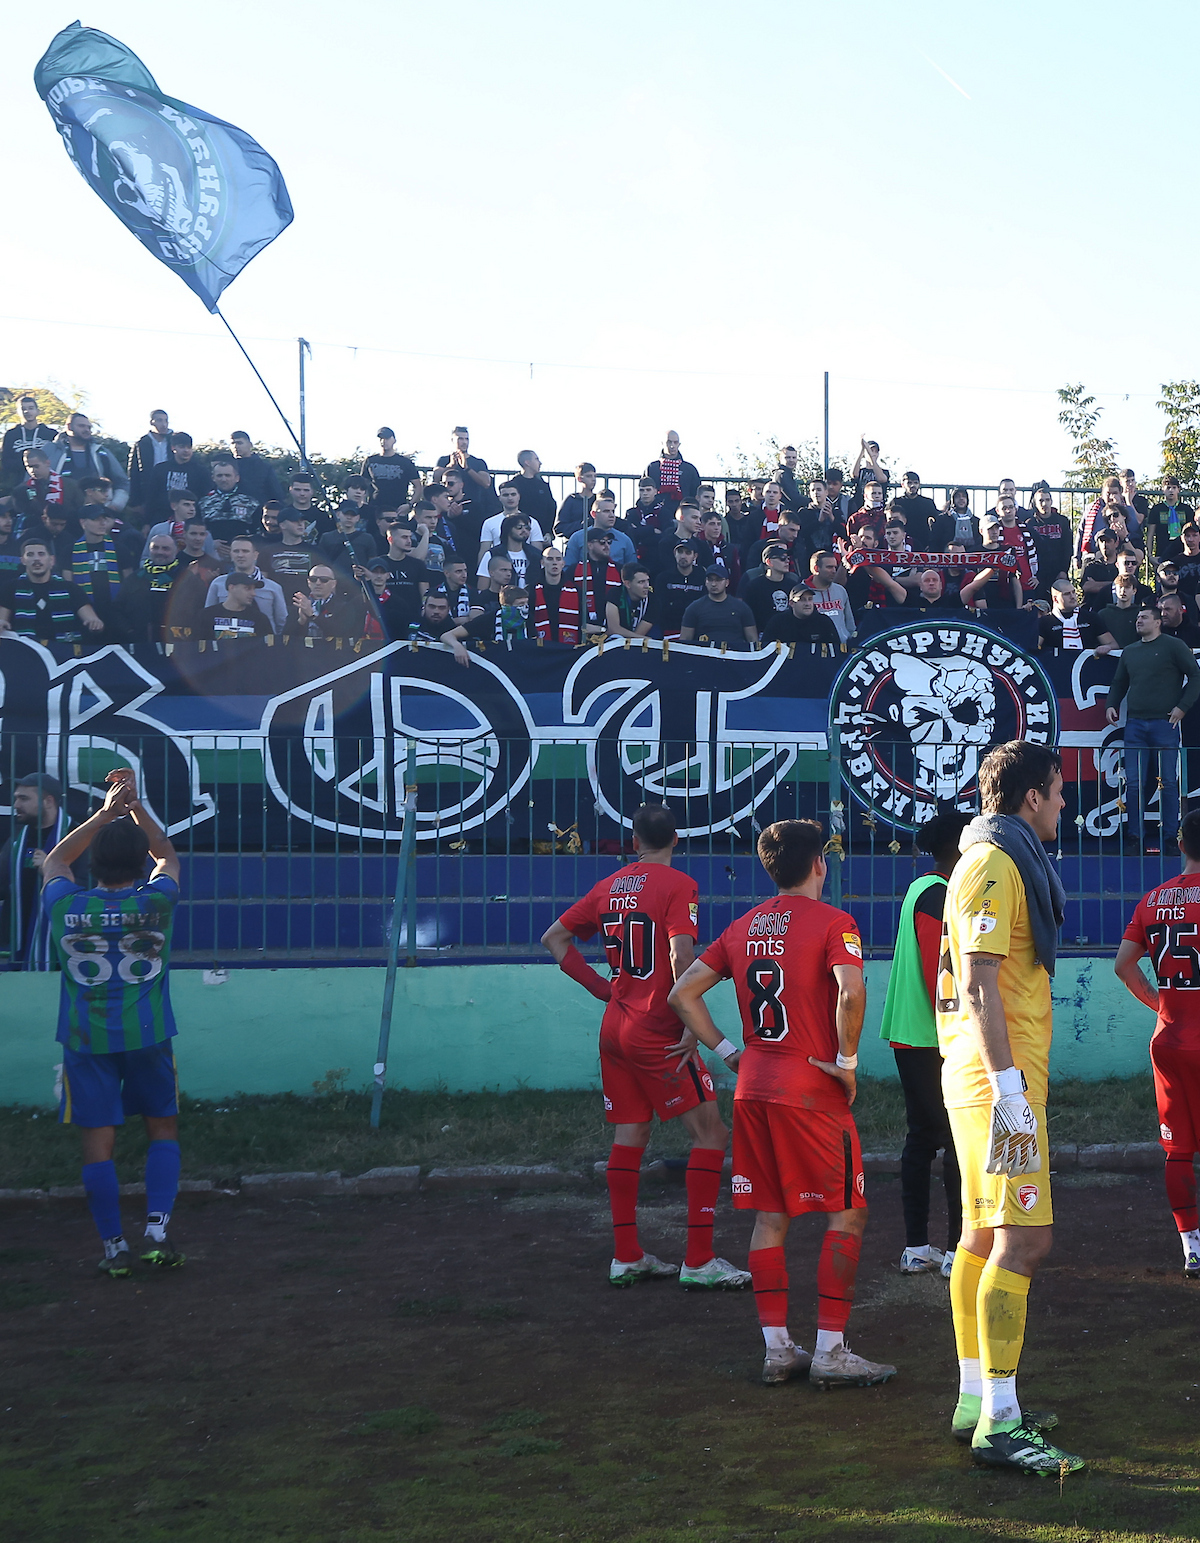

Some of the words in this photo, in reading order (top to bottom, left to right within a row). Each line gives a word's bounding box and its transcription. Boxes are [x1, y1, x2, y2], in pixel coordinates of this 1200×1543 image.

[895, 552, 1000, 565] RADNICKI
[848, 629, 1034, 687] ТАУРУНУМ
[609, 872, 649, 895] DADIĆ
[609, 894, 638, 910] mts
[1156, 905, 1186, 920] mts
[64, 913, 93, 928] ФК
[601, 911, 656, 980] 50
[746, 936, 785, 957] mts
[60, 931, 166, 986] 88
[746, 958, 790, 1042] 8
[732, 1184, 751, 1192] MC
